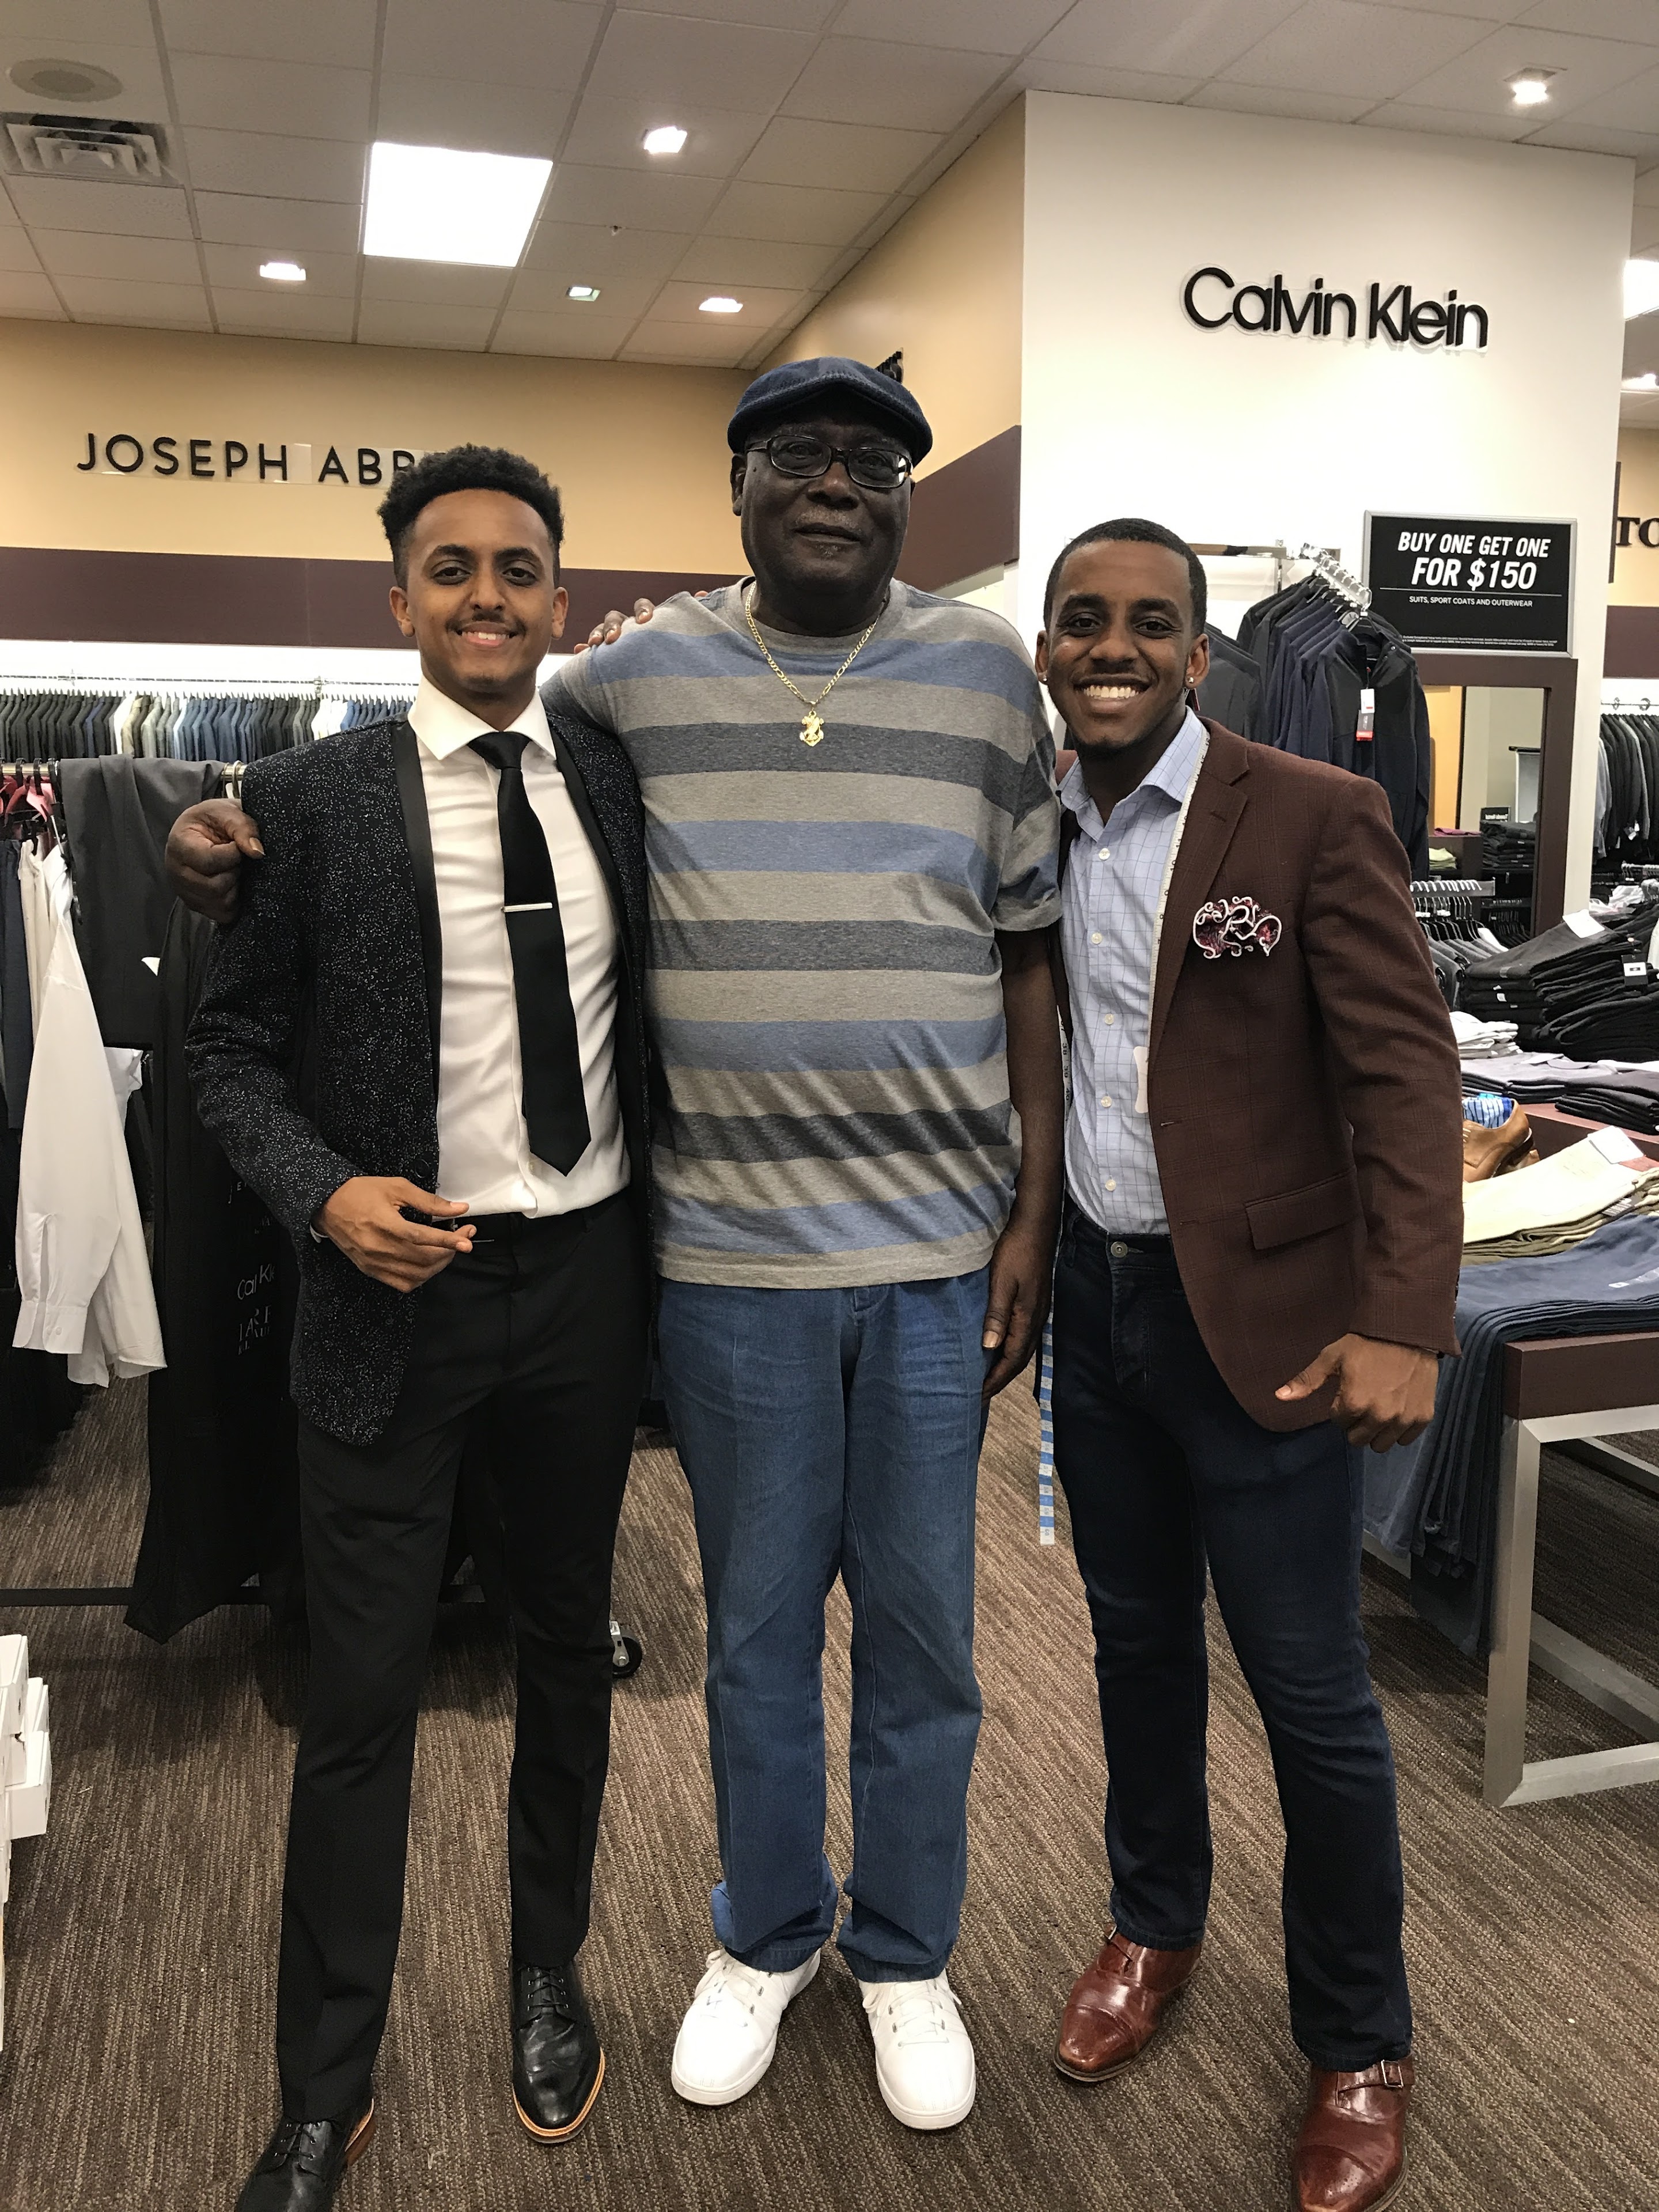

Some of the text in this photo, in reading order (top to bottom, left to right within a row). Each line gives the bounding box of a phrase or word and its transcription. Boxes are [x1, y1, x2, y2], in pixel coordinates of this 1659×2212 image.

[1184, 267, 1488, 348] Calvin Klein
[77, 433, 287, 481] JOSEPH
[1397, 532, 1552, 558] BUY ONE GET ONE
[1411, 557, 1537, 591] FOR $150
[1409, 596, 1430, 604] SUITS,
[1430, 596, 1452, 604] SPORT
[1452, 597, 1475, 605] COATS
[1491, 599, 1533, 607] OUTERWEAR
